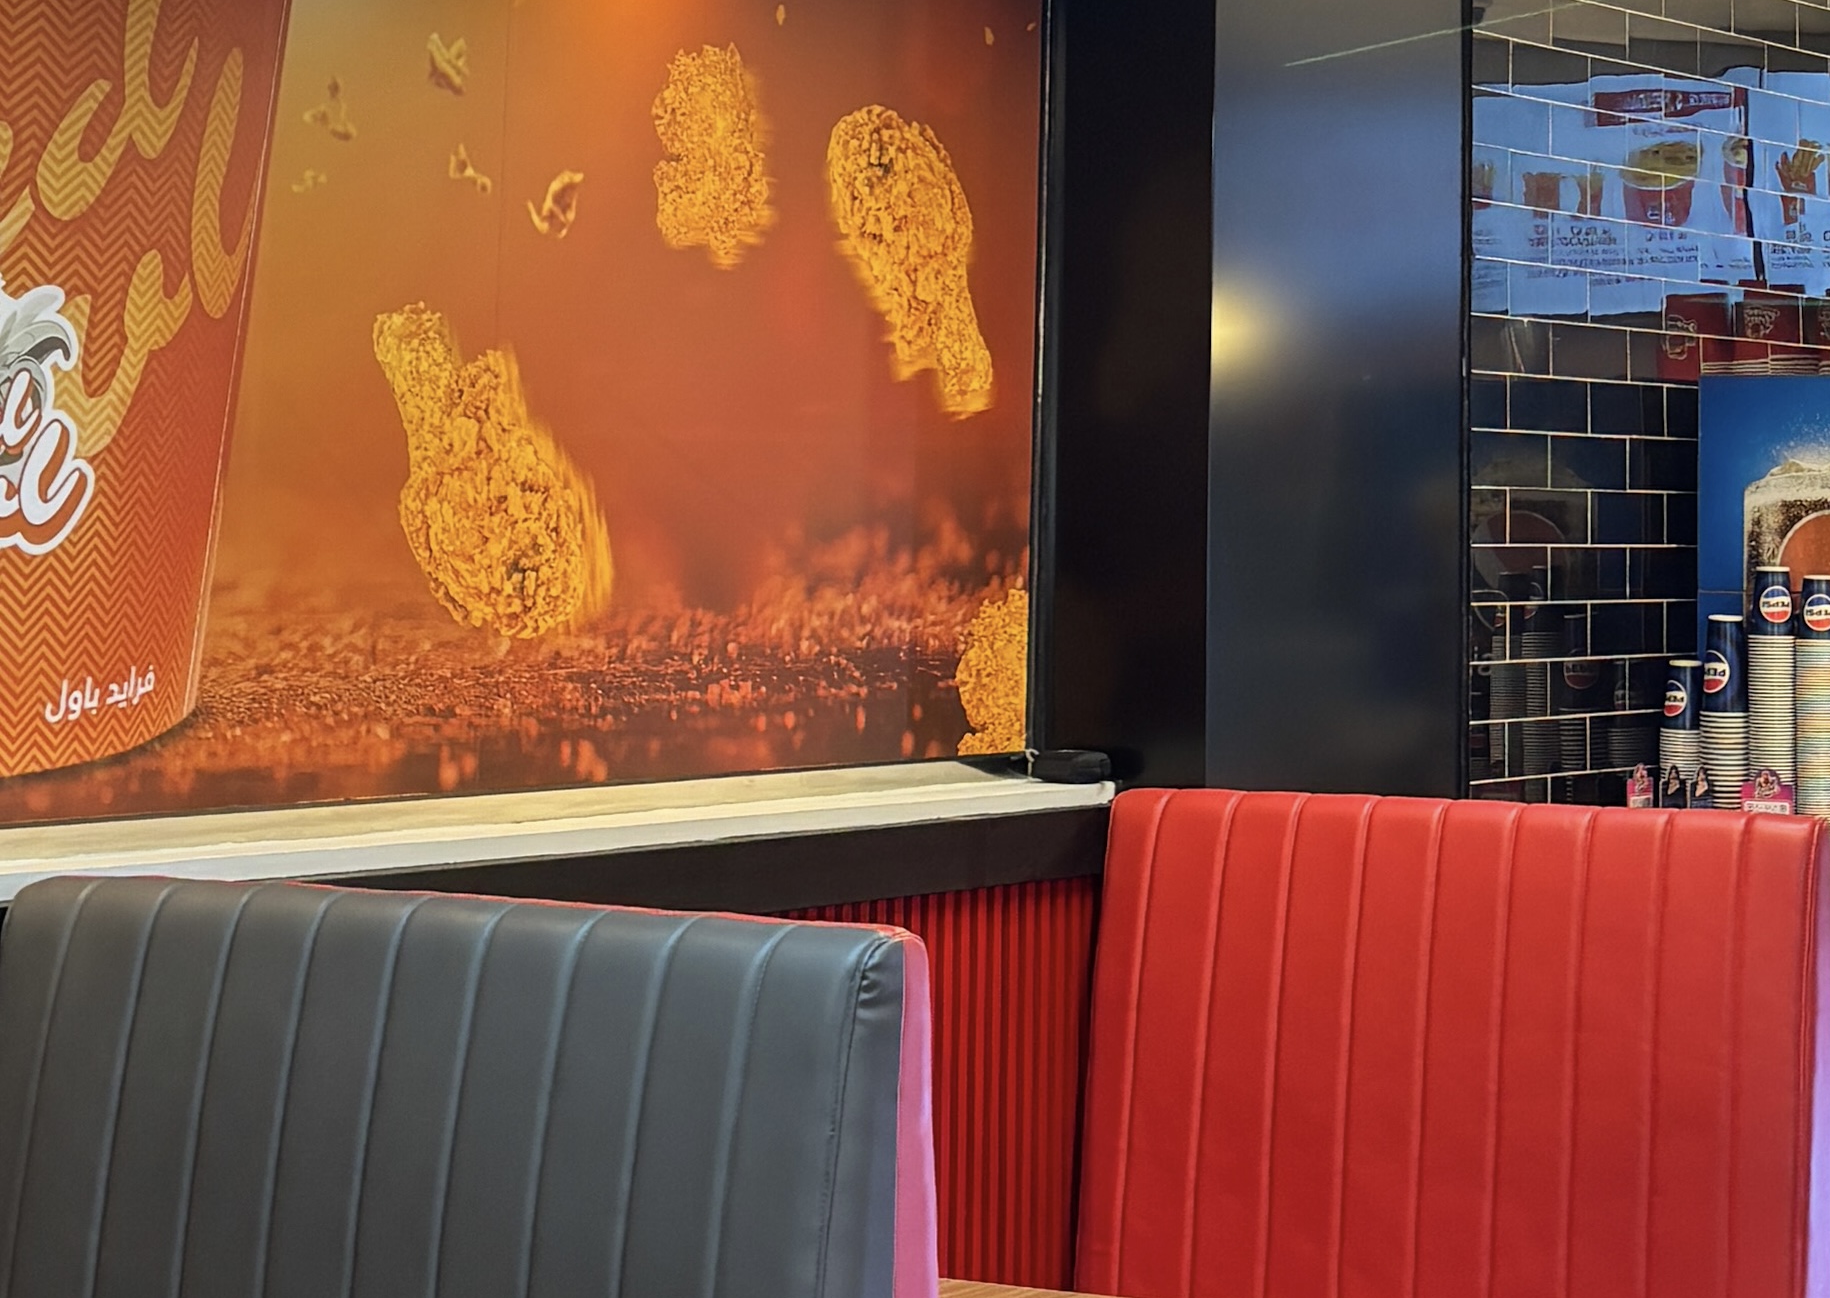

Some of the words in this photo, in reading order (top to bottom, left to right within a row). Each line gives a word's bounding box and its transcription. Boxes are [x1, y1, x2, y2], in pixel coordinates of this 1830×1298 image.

[1761, 600, 1790, 609] PEPSI
[45, 676, 101, 723] باول
[105, 664, 156, 708] فرايد
